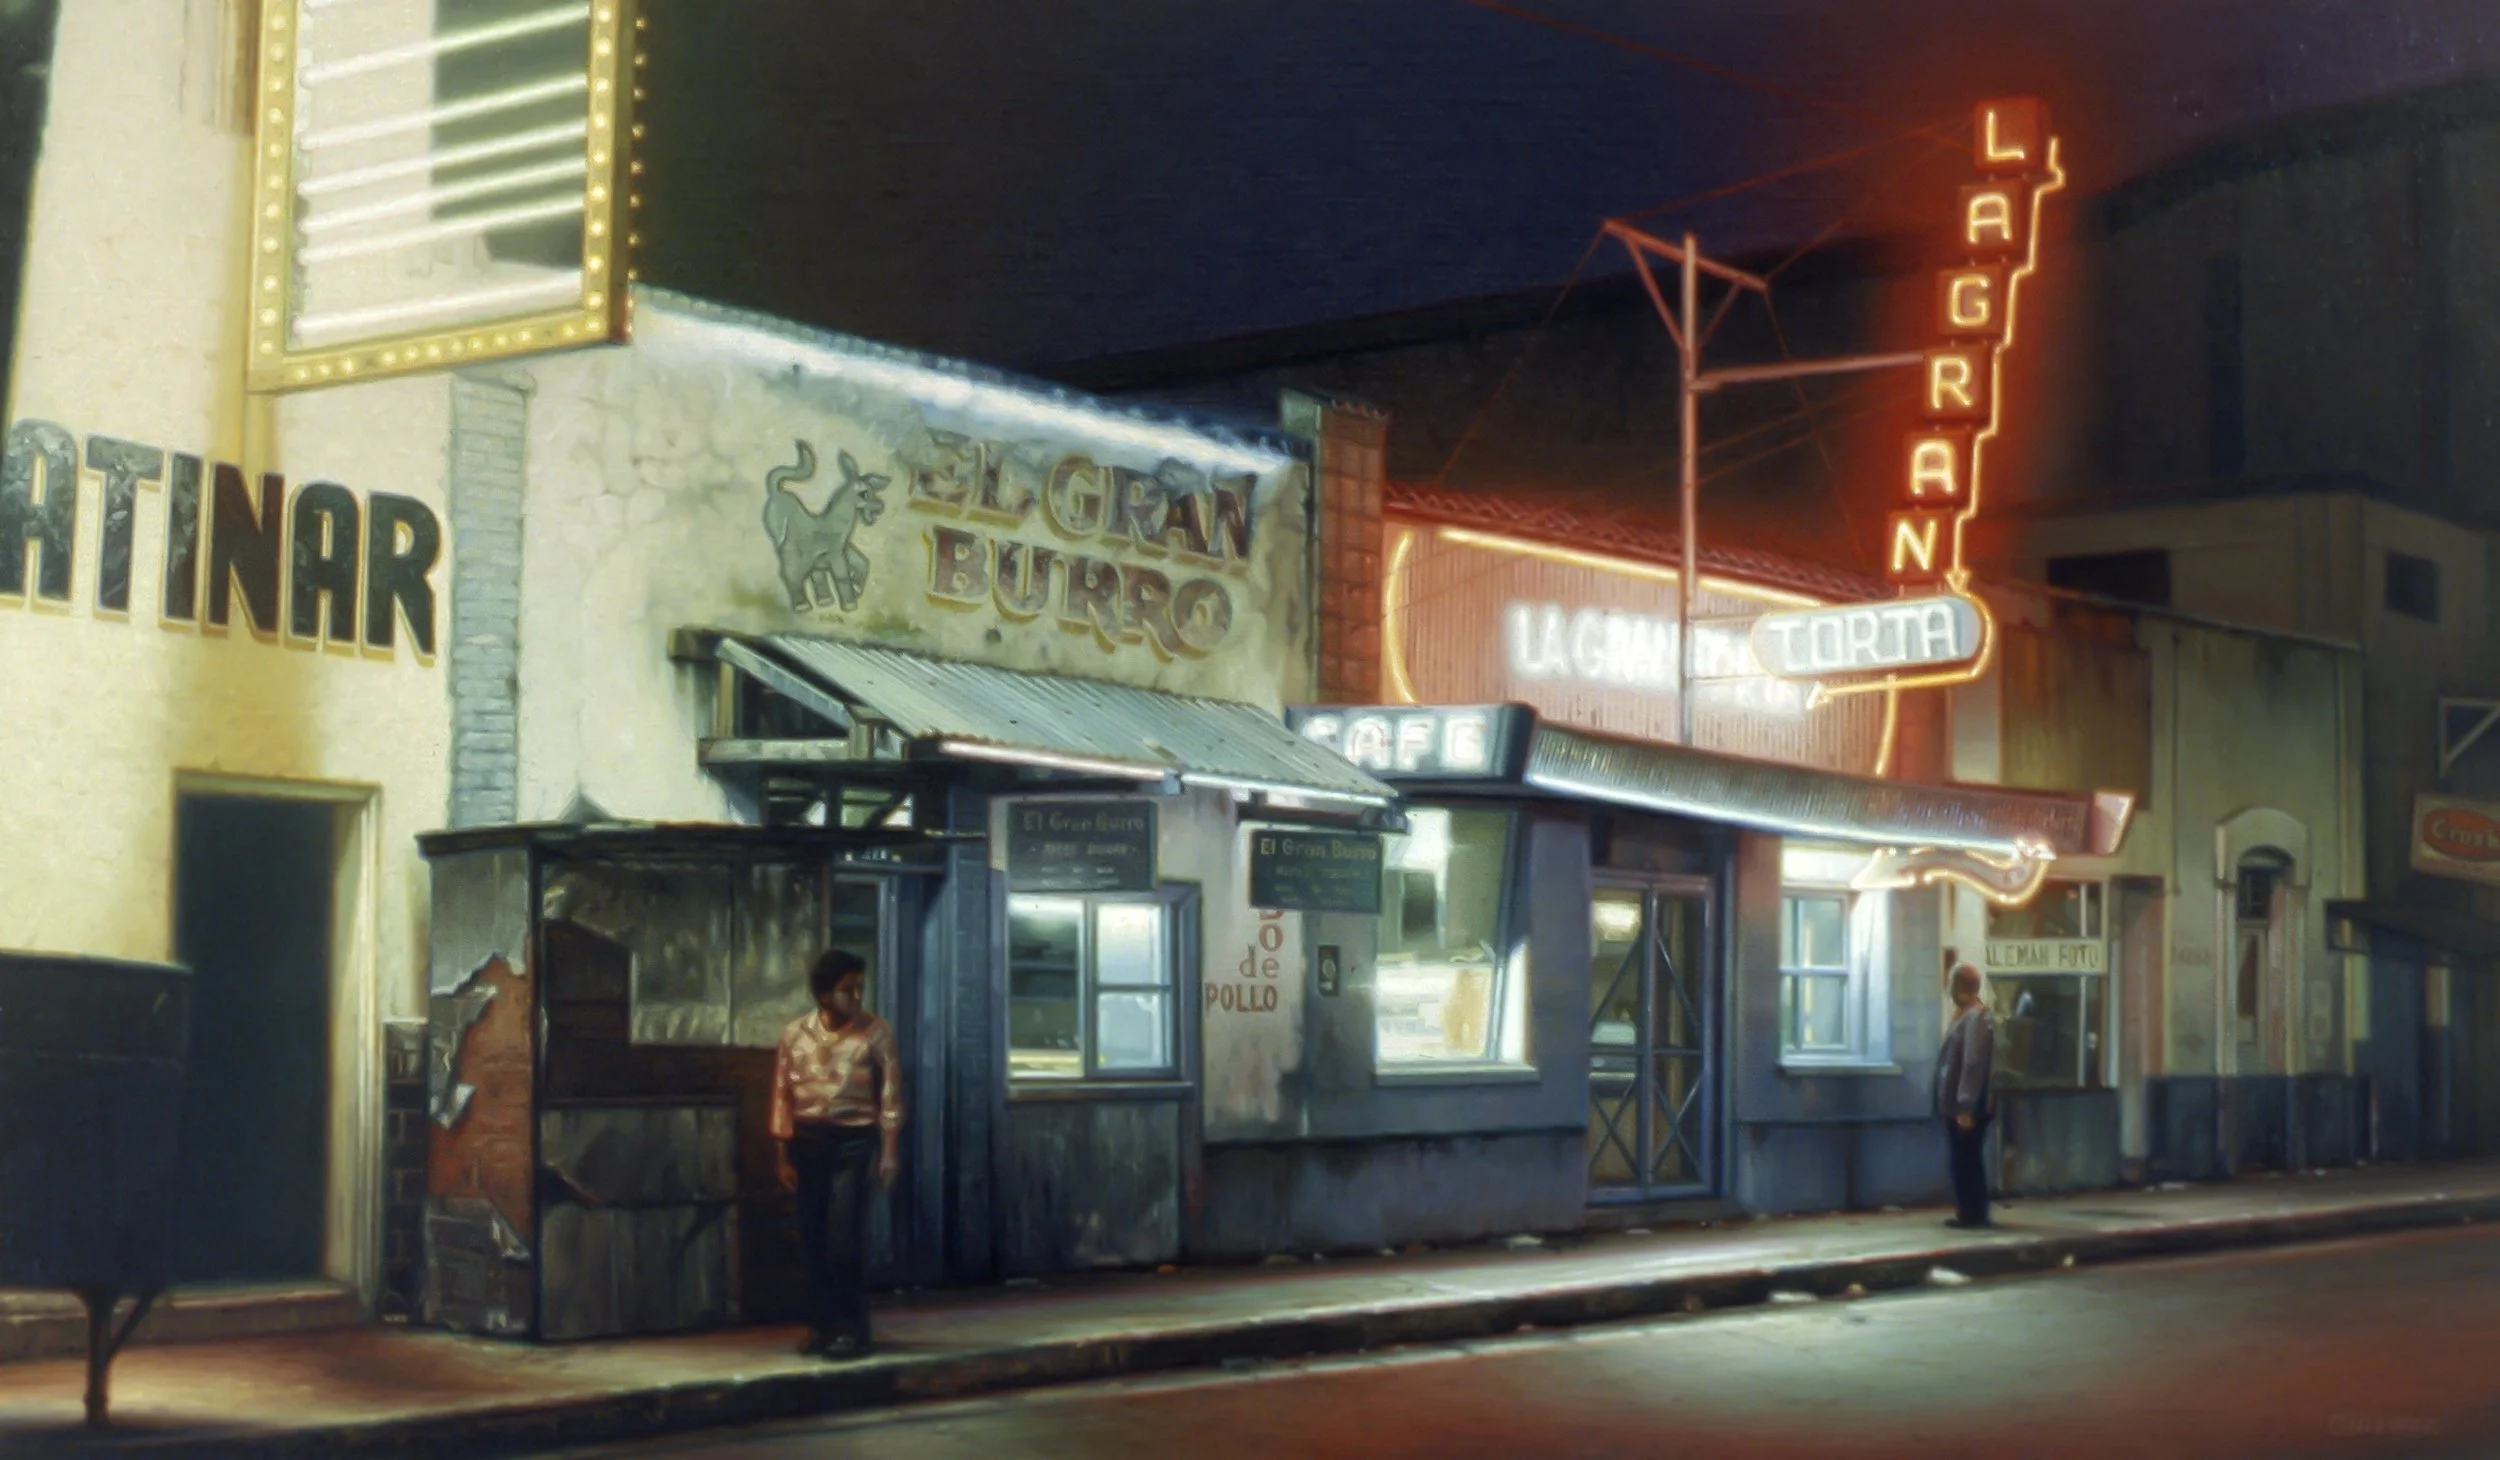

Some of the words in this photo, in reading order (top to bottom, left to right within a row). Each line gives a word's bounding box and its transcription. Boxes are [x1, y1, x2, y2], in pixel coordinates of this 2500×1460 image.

[905, 430, 1036, 529] EL
[1041, 452, 1259, 575] GRAN
[0, 418, 442, 668] ATINAR
[921, 525, 1234, 663] BURRO
[1508, 603, 1570, 674] LA
[1768, 602, 1961, 674] TORTA
[1260, 837, 1277, 856] El
[1281, 838, 1326, 858] Gran
[1239, 943, 1280, 979] de
[1203, 982, 1278, 1014] POLLO
